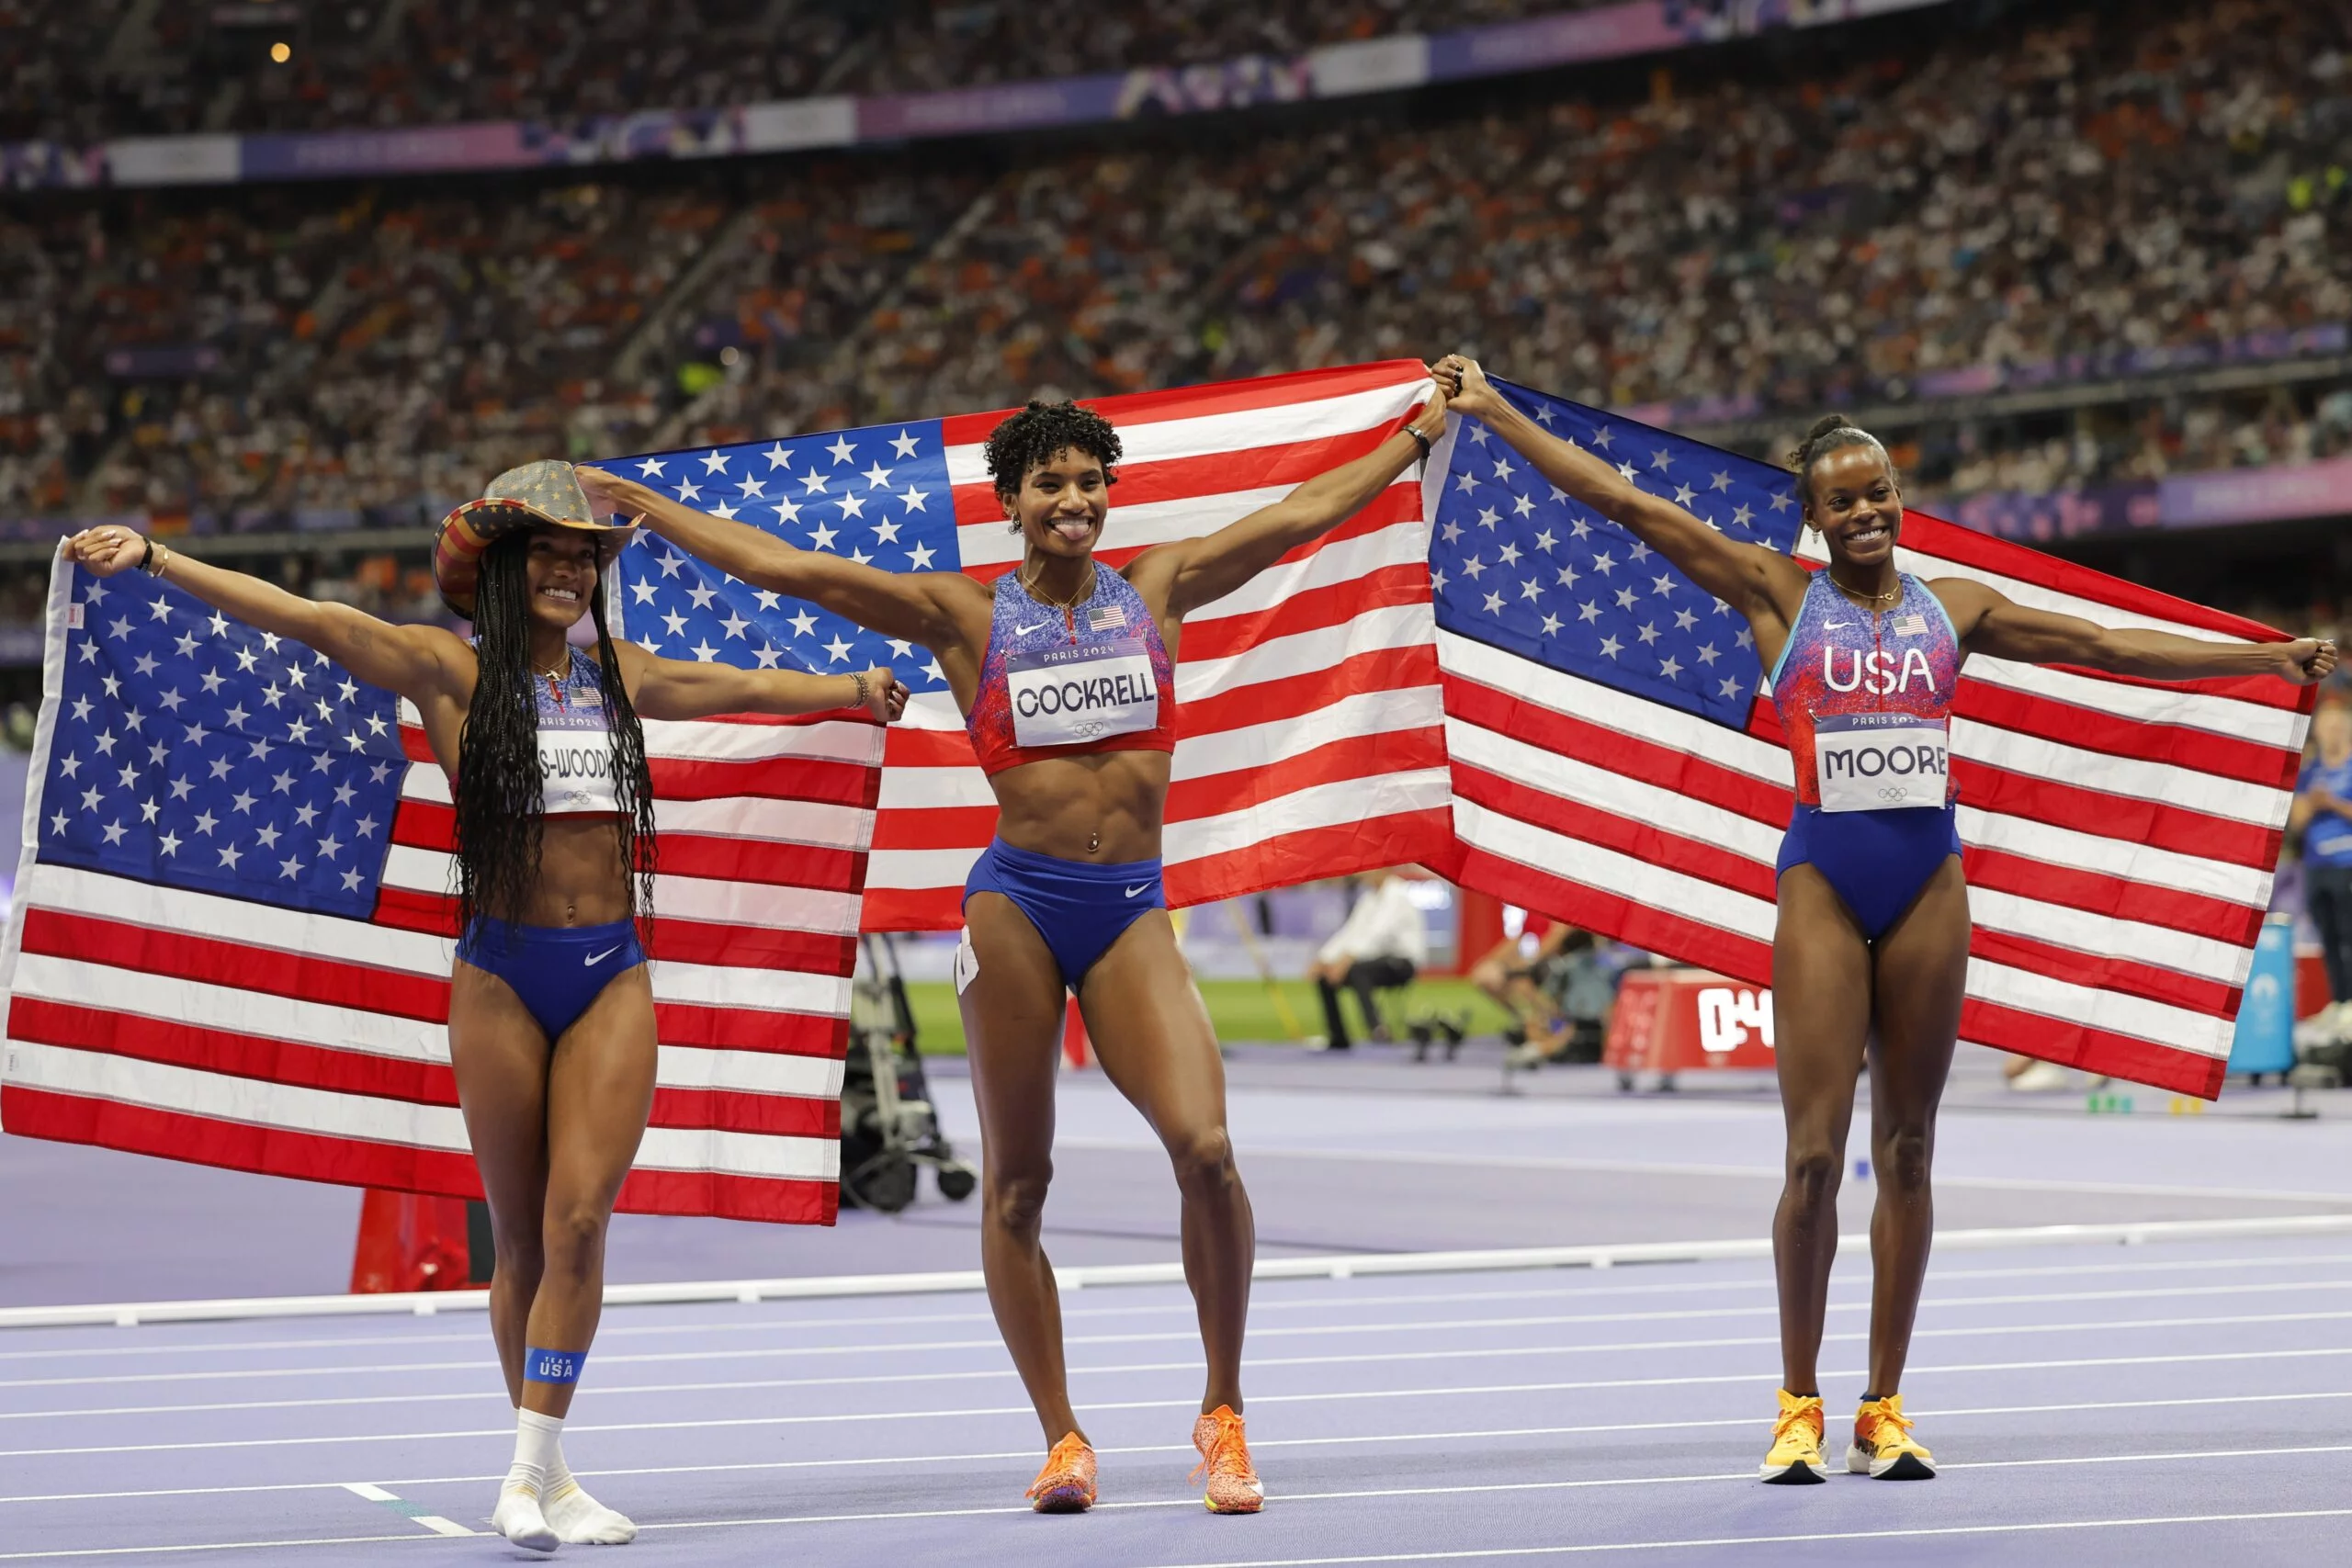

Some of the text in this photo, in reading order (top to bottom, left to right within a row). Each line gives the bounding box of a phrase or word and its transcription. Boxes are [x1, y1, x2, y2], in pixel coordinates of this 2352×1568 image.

[1044, 646, 1114, 662] PARIS 2024
[1824, 646, 1936, 694] USA
[1017, 673, 1154, 718] COCKRELL
[539, 717, 599, 728] ARIS 2024
[1852, 716, 1888, 726] PARIS
[1825, 746, 1947, 779] MOORE
[540, 1362, 572, 1377] USA
